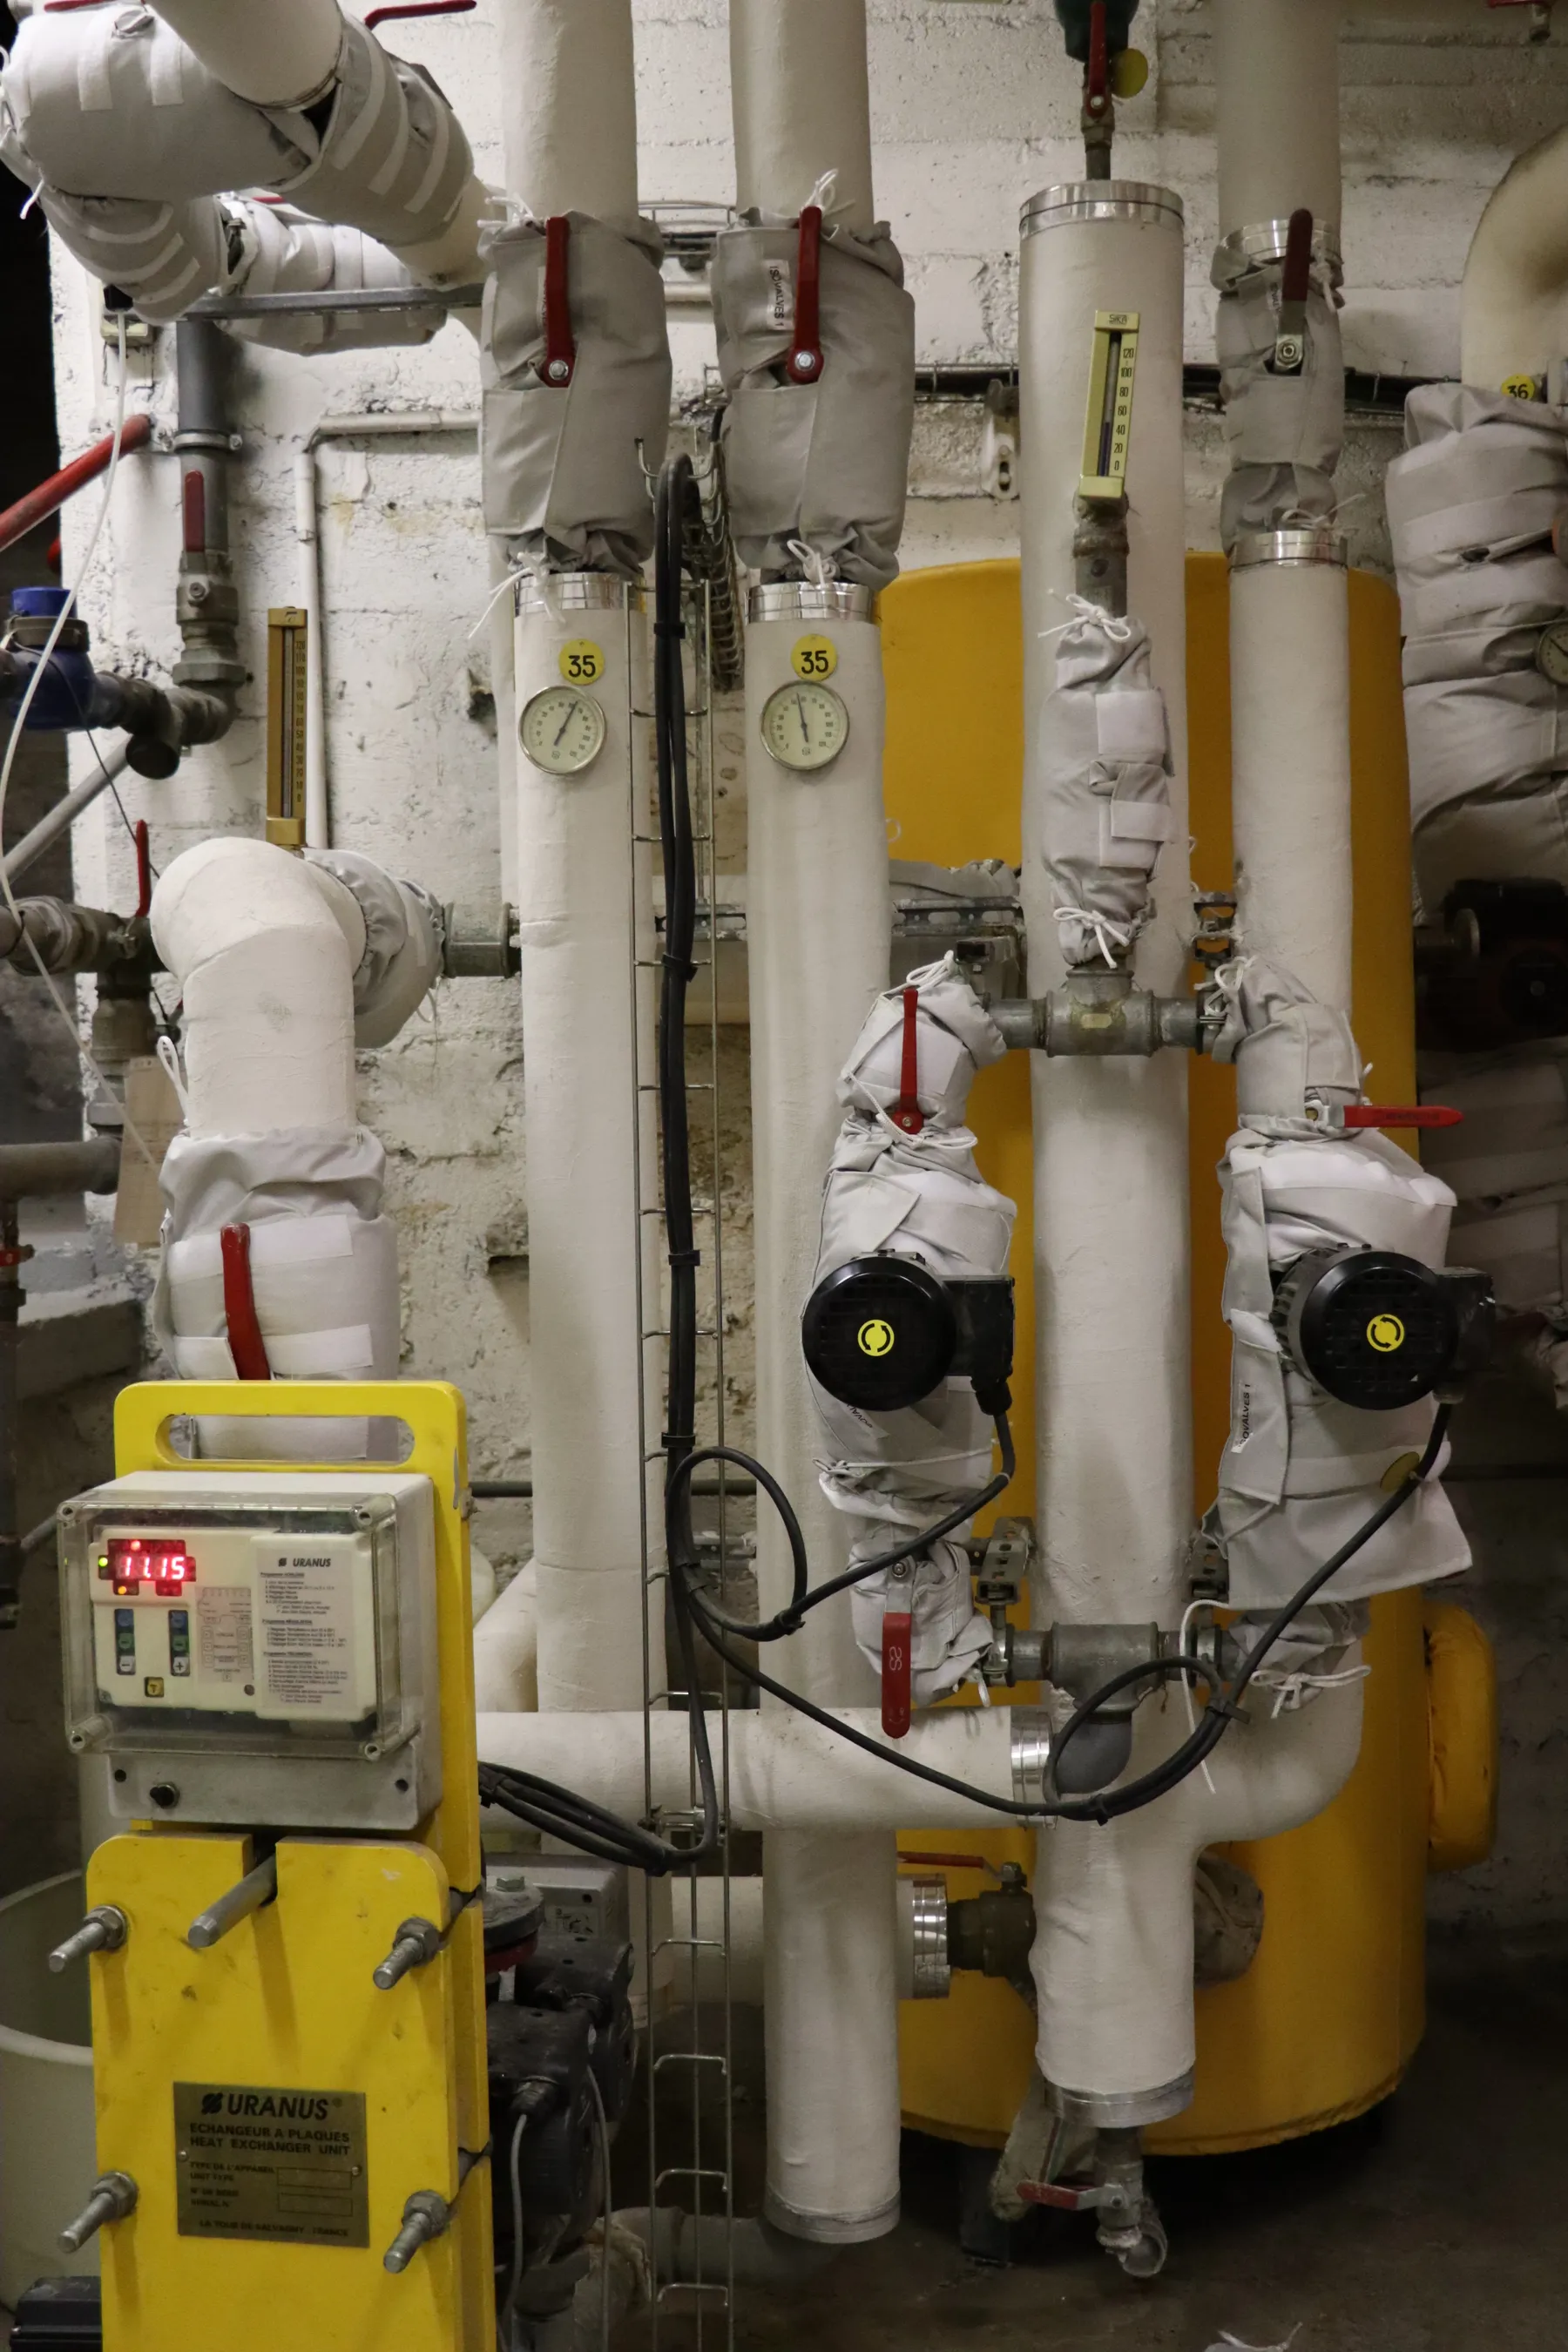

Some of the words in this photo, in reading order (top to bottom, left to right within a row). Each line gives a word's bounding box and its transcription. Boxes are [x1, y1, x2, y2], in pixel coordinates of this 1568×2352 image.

[769, 265, 785, 320] ISOVALVES
[1123, 348, 1134, 359] 120
[1120, 367, 1132, 378] 100
[1119, 386, 1129, 397] 80
[1507, 383, 1529, 400] 36
[1118, 405, 1127, 416] 60
[1115, 424, 1125, 436] 40
[1113, 443, 1123, 453] 20
[1114, 460, 1120, 470] 0
[568, 655, 597, 678] 35
[801, 650, 829, 674] 35
[125, 1556, 186, 1580] 11.15
[293, 1558, 332, 1567] URANUS
[227, 2093, 329, 2120] URANUS
[190, 2122, 271, 2137] ECHANGEUR
[274, 2128, 284, 2139] A
[288, 2128, 350, 2143] PLAQUES
[190, 2136, 224, 2148] HEAT
[231, 2139, 312, 2153] EXCHANGER
[319, 2144, 351, 2156] UNIT
